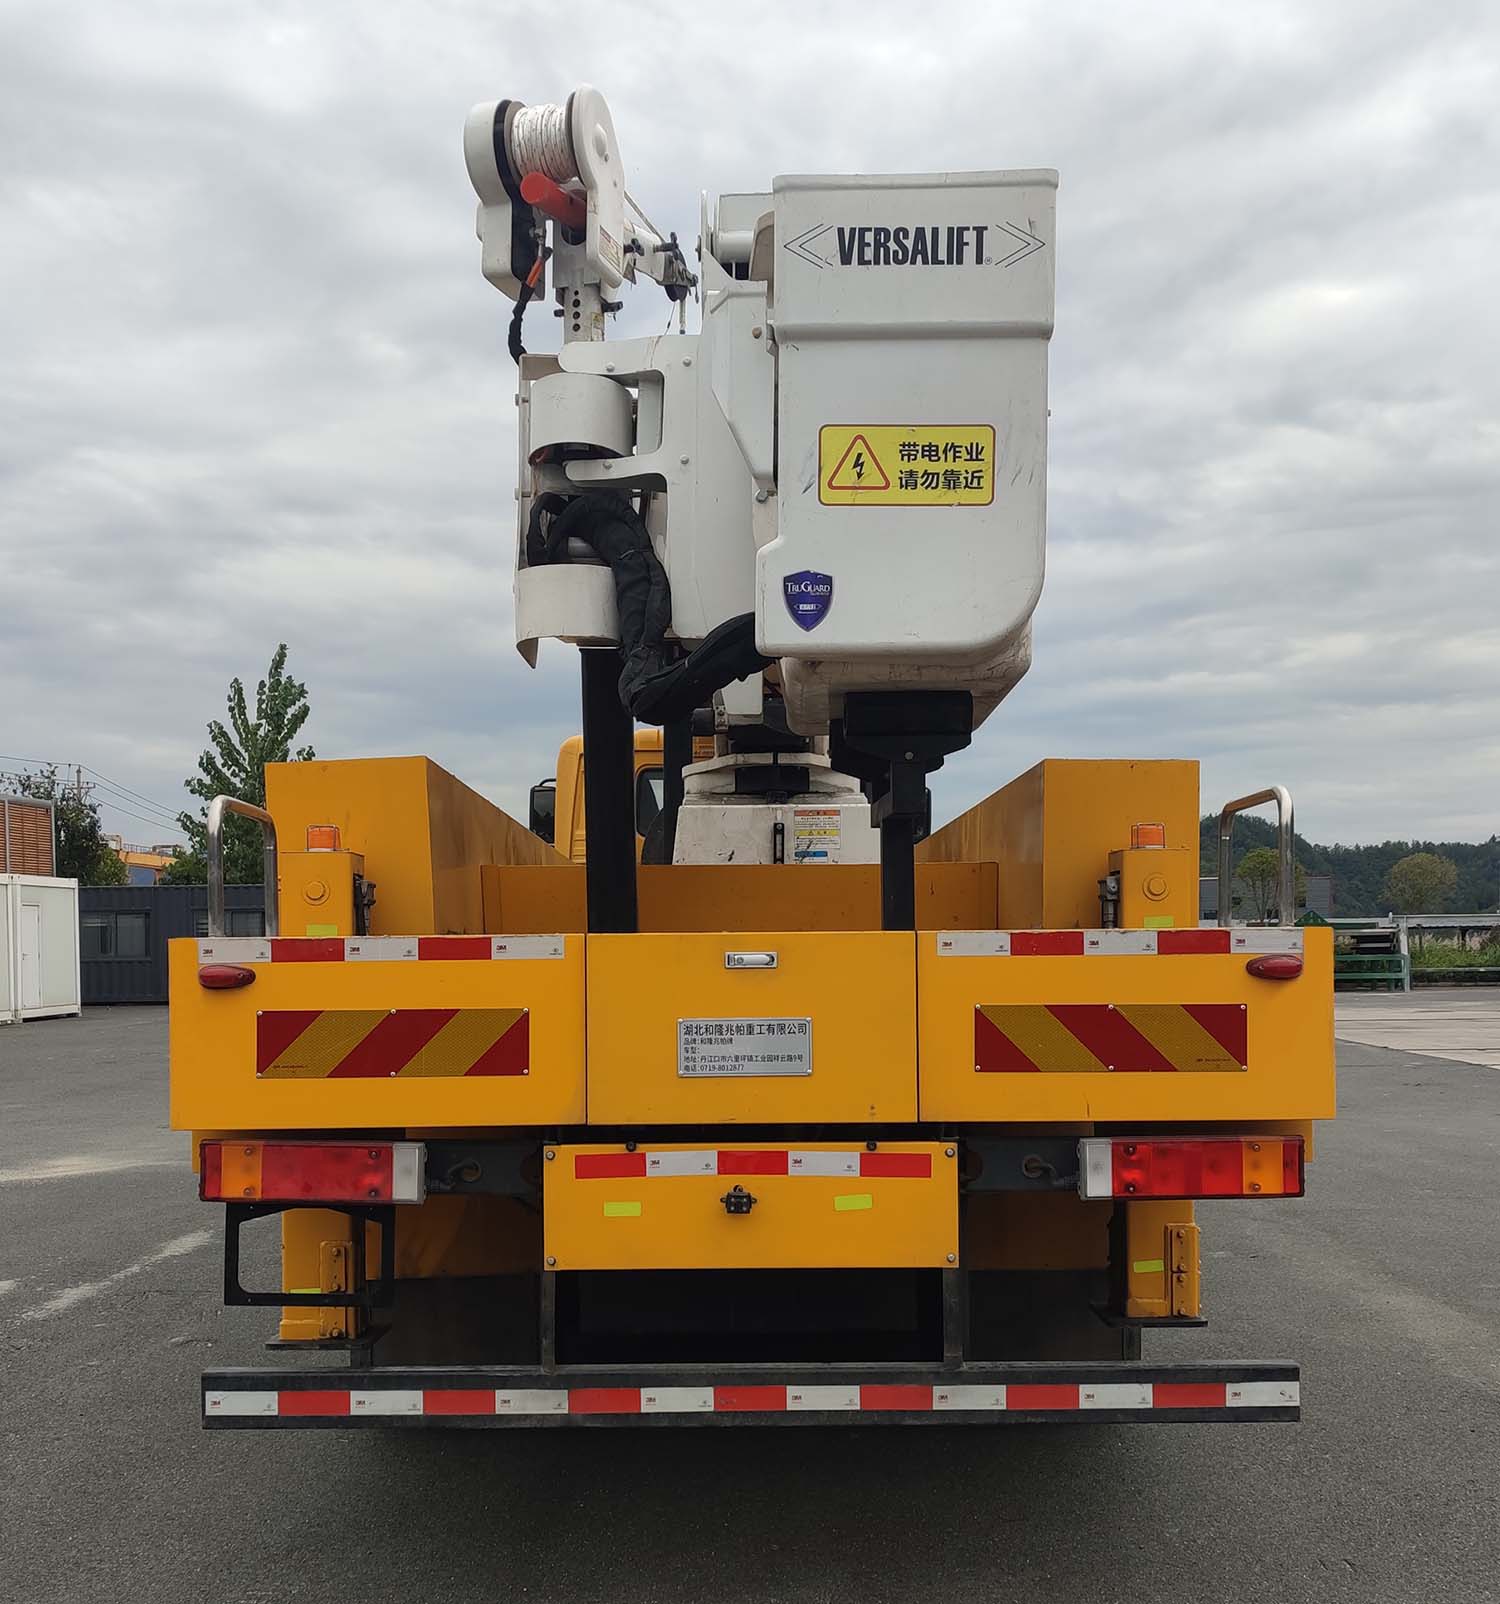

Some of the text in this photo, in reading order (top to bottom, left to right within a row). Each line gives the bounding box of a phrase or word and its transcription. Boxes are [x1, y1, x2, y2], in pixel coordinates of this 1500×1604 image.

[837, 226, 988, 266] VERSALIFT
[898, 441, 985, 463] 带电作业
[898, 469, 985, 490] 请勿靠近
[683, 1023, 808, 1036] 湖北和隆兆帕重工有限公司
